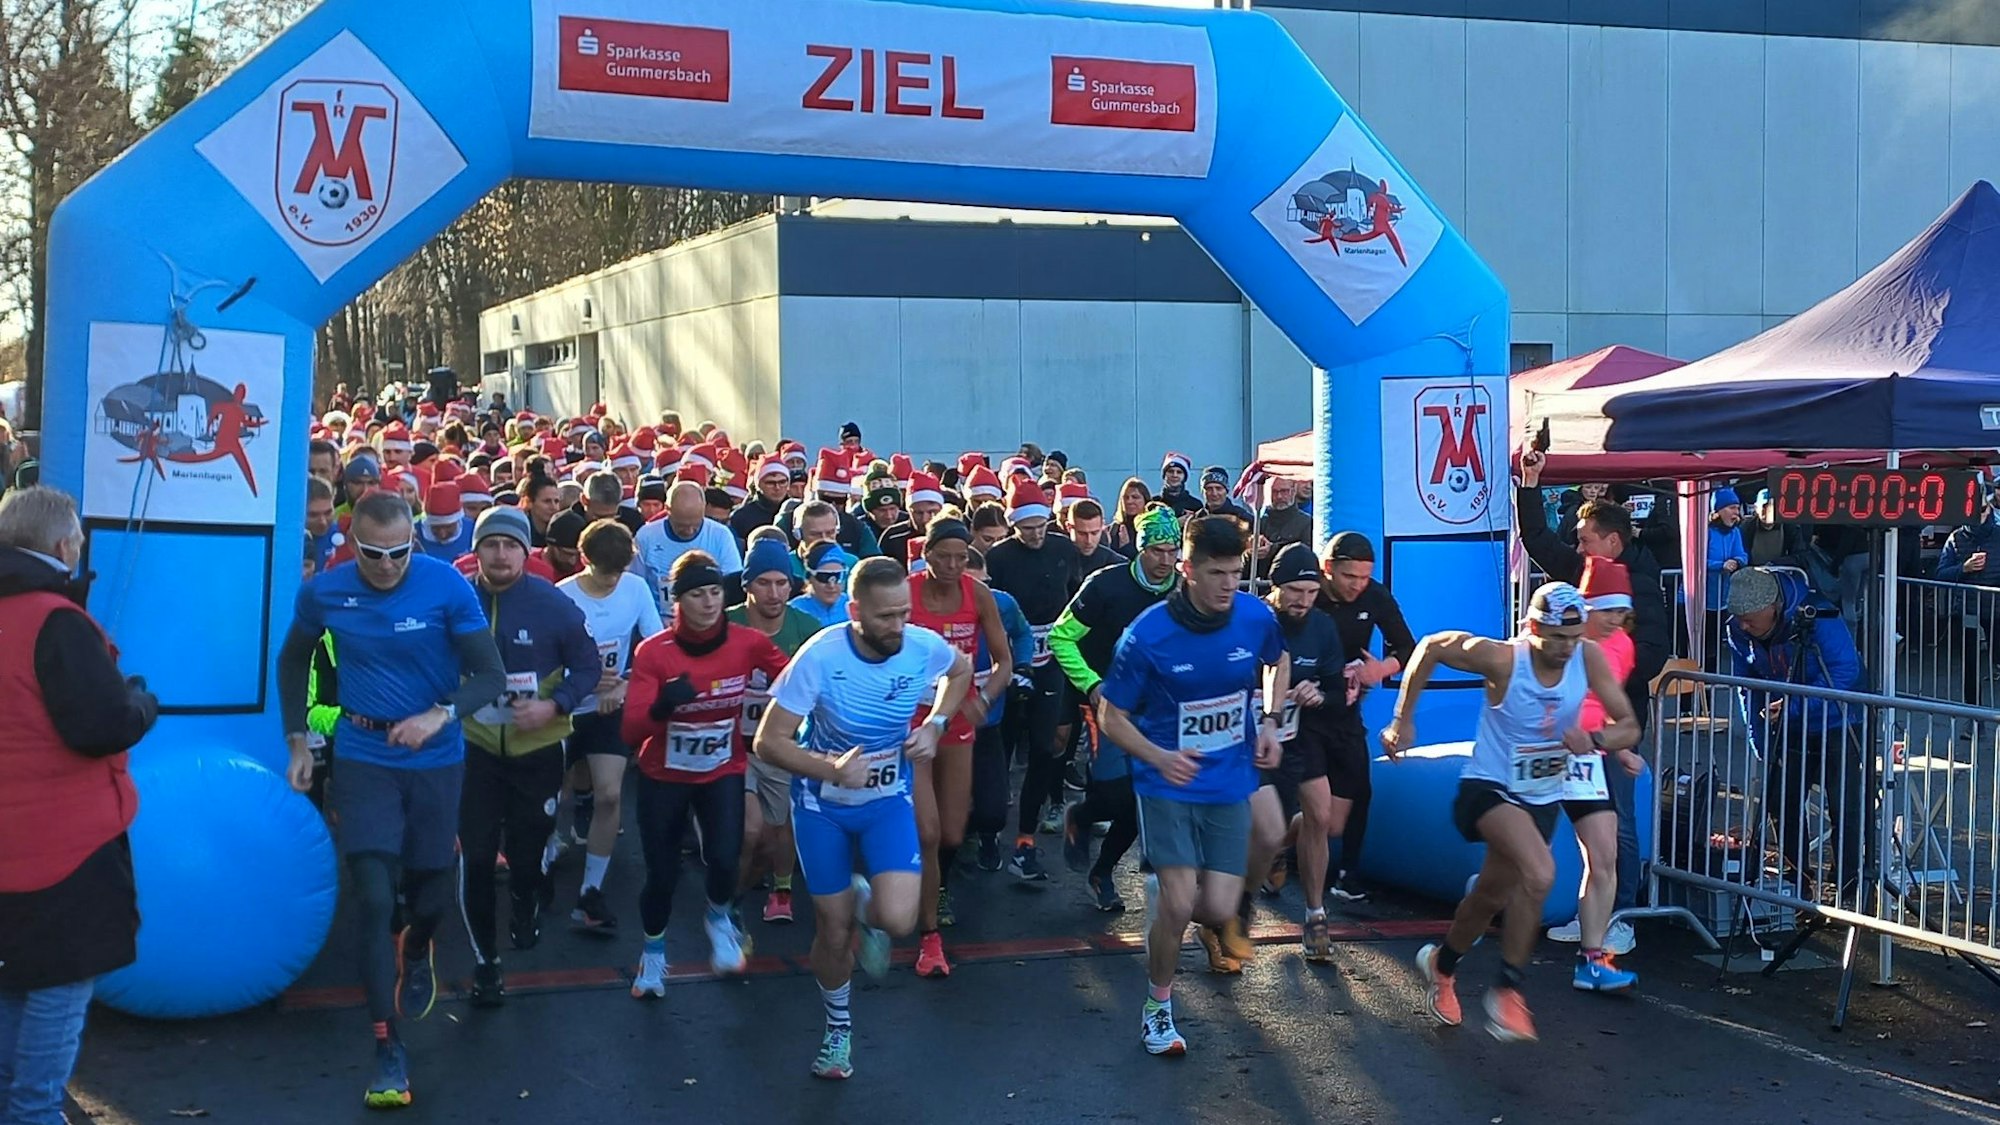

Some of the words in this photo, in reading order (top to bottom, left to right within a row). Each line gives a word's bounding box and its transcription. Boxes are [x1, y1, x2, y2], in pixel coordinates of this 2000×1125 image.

[606, 43, 681, 62] Sparkasse
[606, 62, 711, 83] Gummersbach
[801, 44, 984, 120] ZIEL
[1091, 79, 1154, 97] Sparkasse
[1091, 97, 1181, 115] Gummersbach
[288, 204, 313, 231] e.V.
[345, 204, 378, 233] 1930
[1427, 493, 1447, 512] e.V.
[1778, 473, 1976, 520] 00:00:01
[1182, 706, 1244, 737] 2002
[671, 733, 730, 756] 1764
